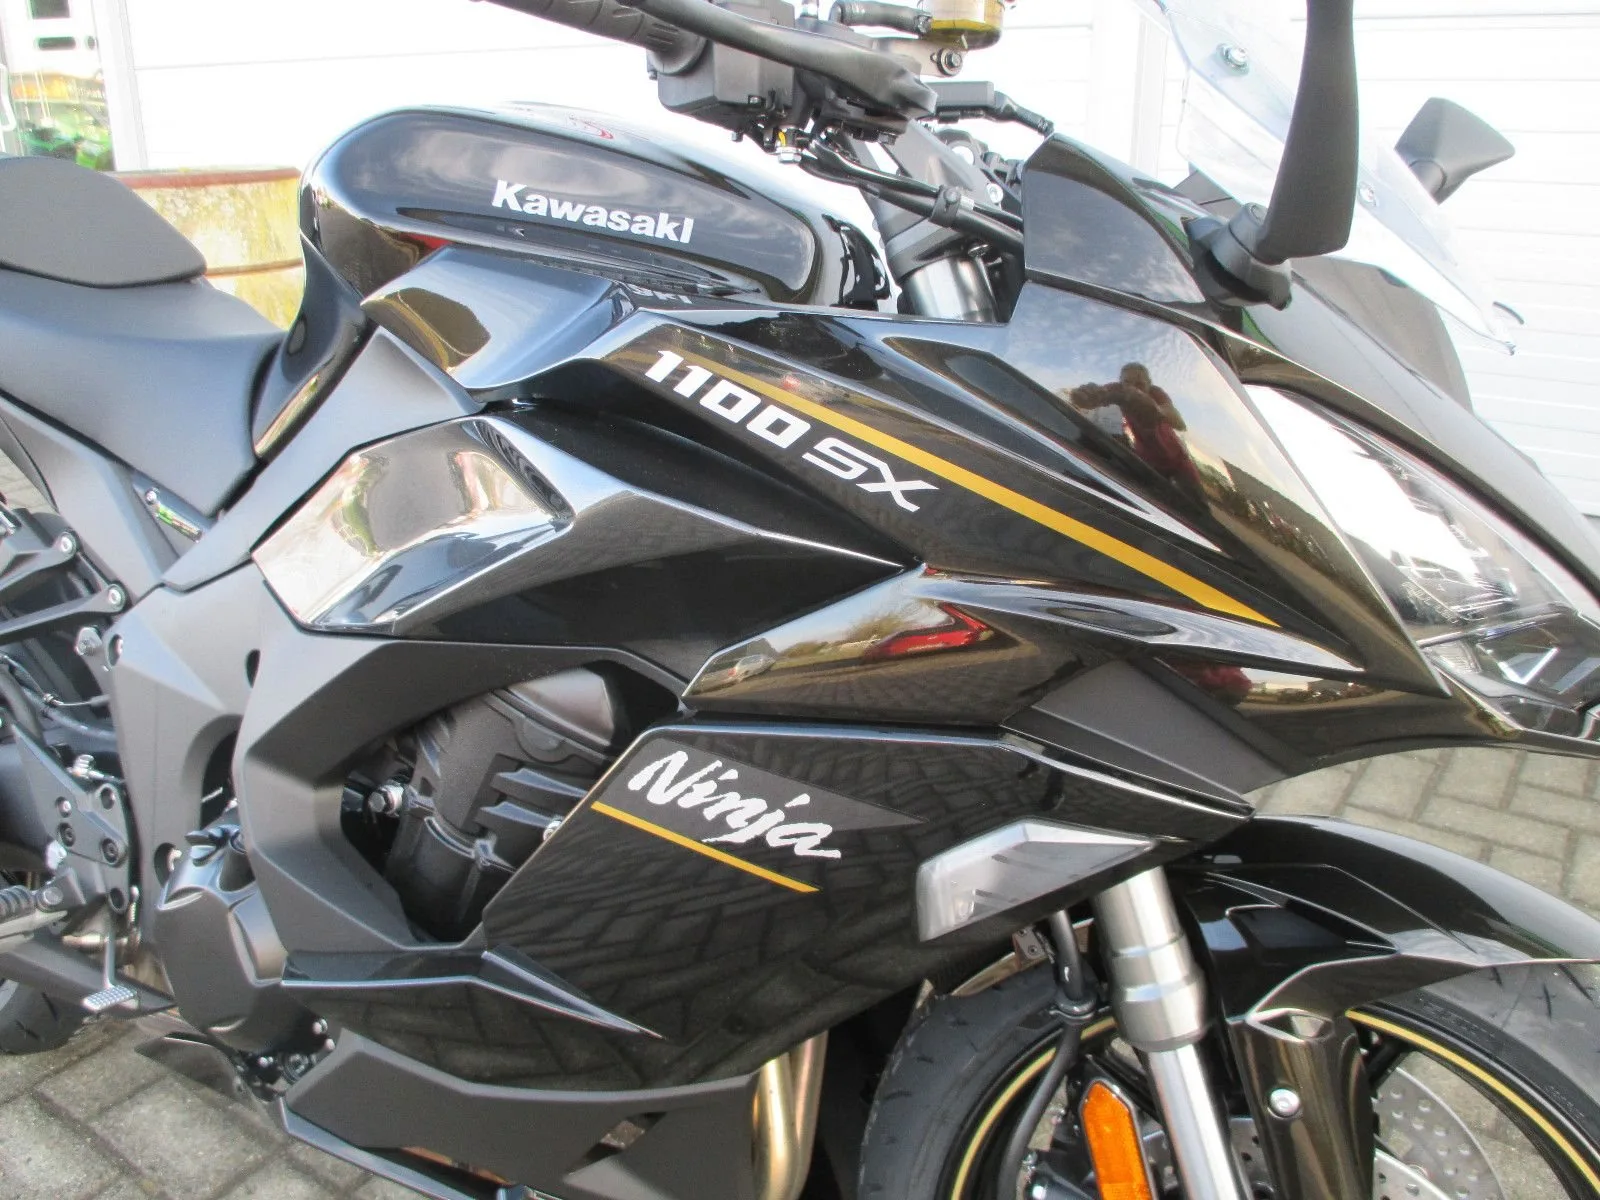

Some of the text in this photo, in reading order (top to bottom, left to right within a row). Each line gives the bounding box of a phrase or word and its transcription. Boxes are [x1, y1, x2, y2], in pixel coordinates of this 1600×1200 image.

[492, 179, 694, 244] Kawasaki
[645, 350, 939, 513] 1100 SX
[628, 751, 842, 859] Ninja
